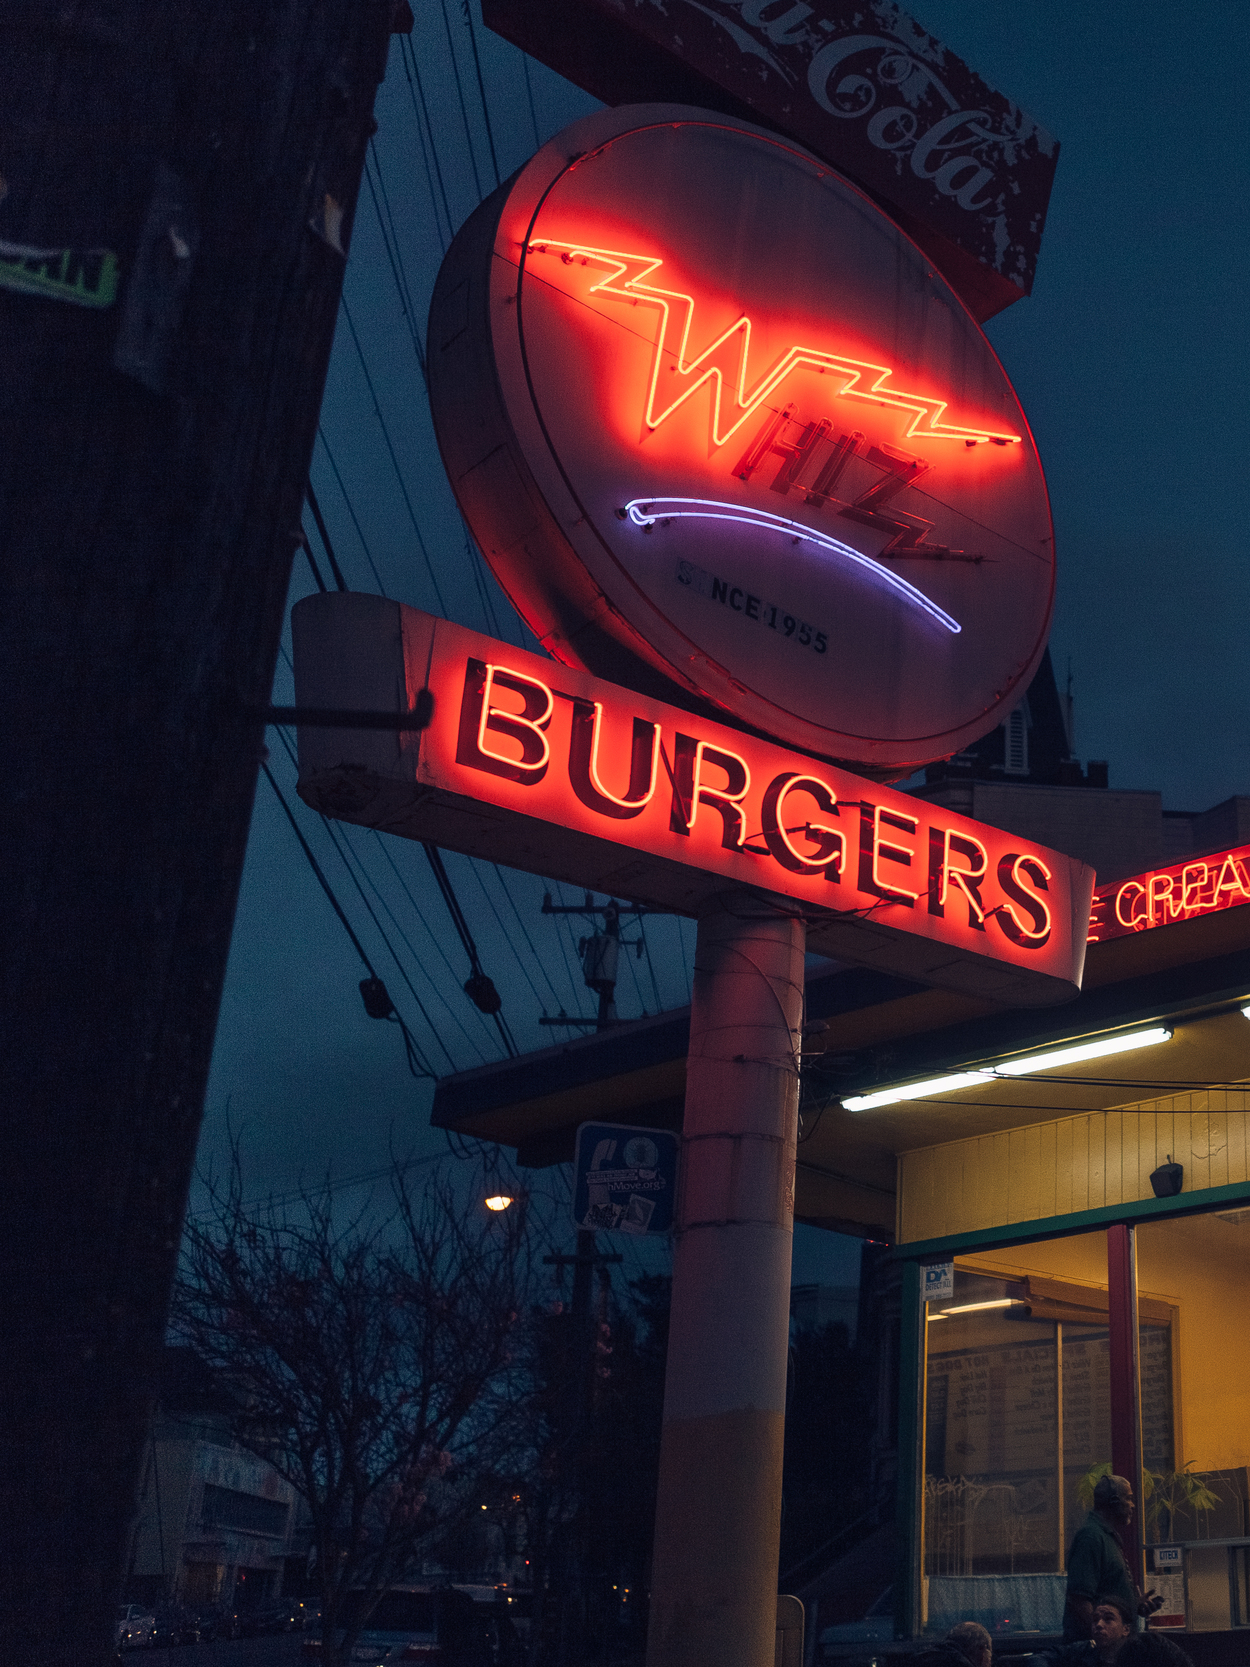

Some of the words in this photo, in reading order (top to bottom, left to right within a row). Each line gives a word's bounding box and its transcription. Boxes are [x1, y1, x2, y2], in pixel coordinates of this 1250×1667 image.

[807, 34, 1012, 211] Cola
[677, 558, 761, 622] SNCE
[765, 606, 829, 656] 1955
[455, 657, 1052, 950] BURGERS
[926, 1269, 947, 1283] DA
